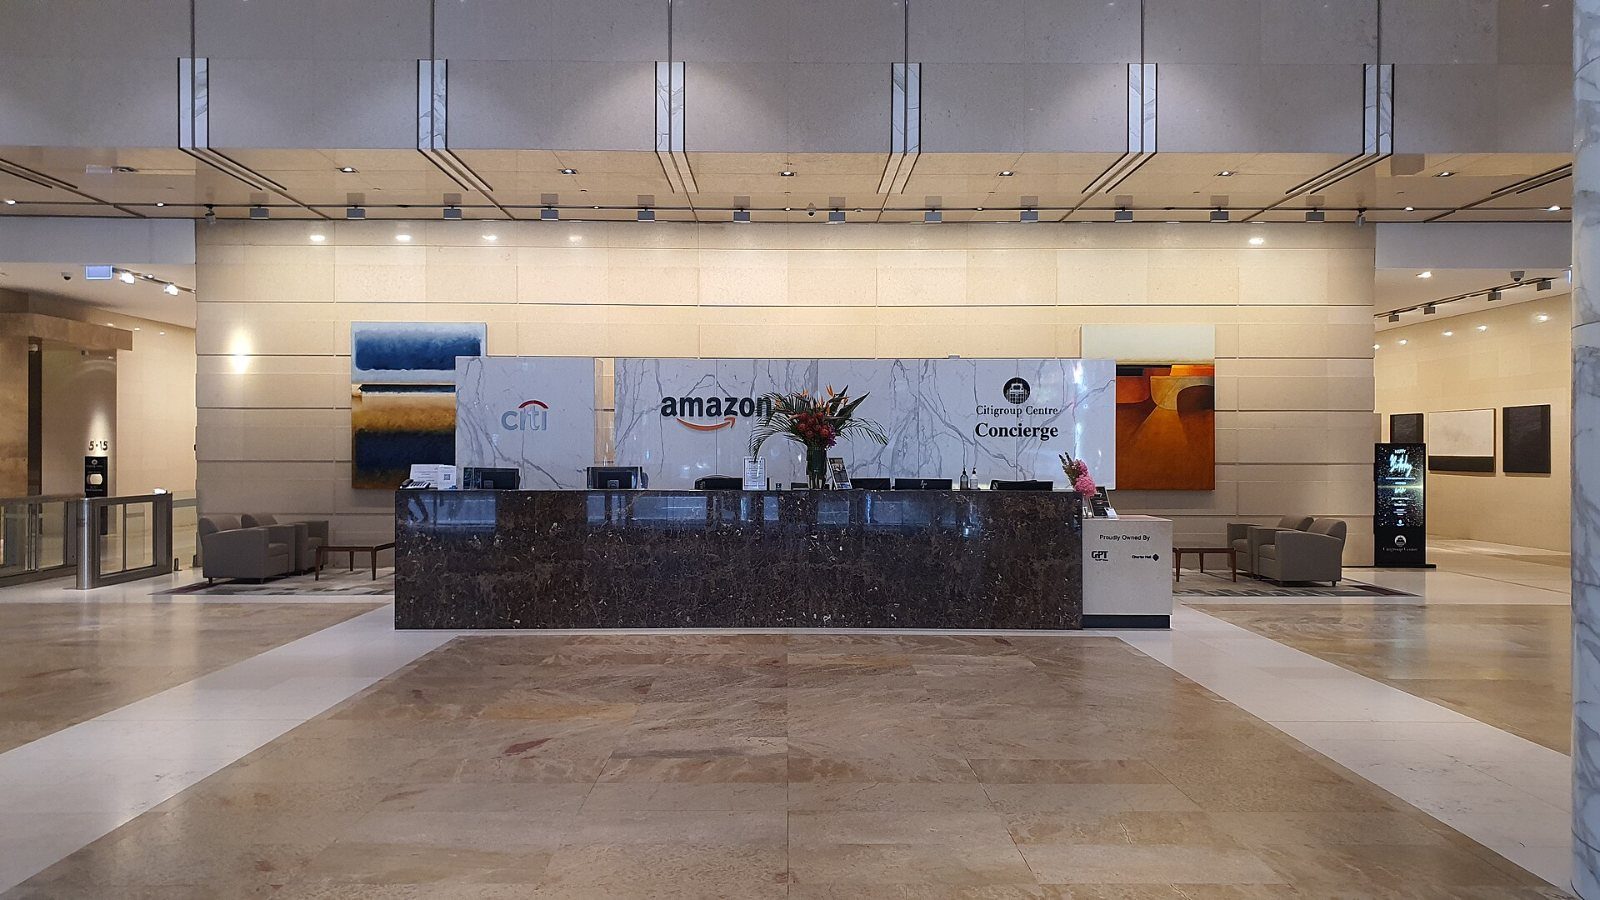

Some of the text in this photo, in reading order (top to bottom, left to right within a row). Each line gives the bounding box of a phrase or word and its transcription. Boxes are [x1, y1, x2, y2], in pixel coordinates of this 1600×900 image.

[661, 396, 772, 418] amazon
[976, 405, 1059, 418] Citigroup Centre
[501, 402, 548, 431] citi
[975, 422, 1059, 441] Concierge
[1099, 534, 1121, 542] Proudly
[1091, 550, 1109, 559] GPT
